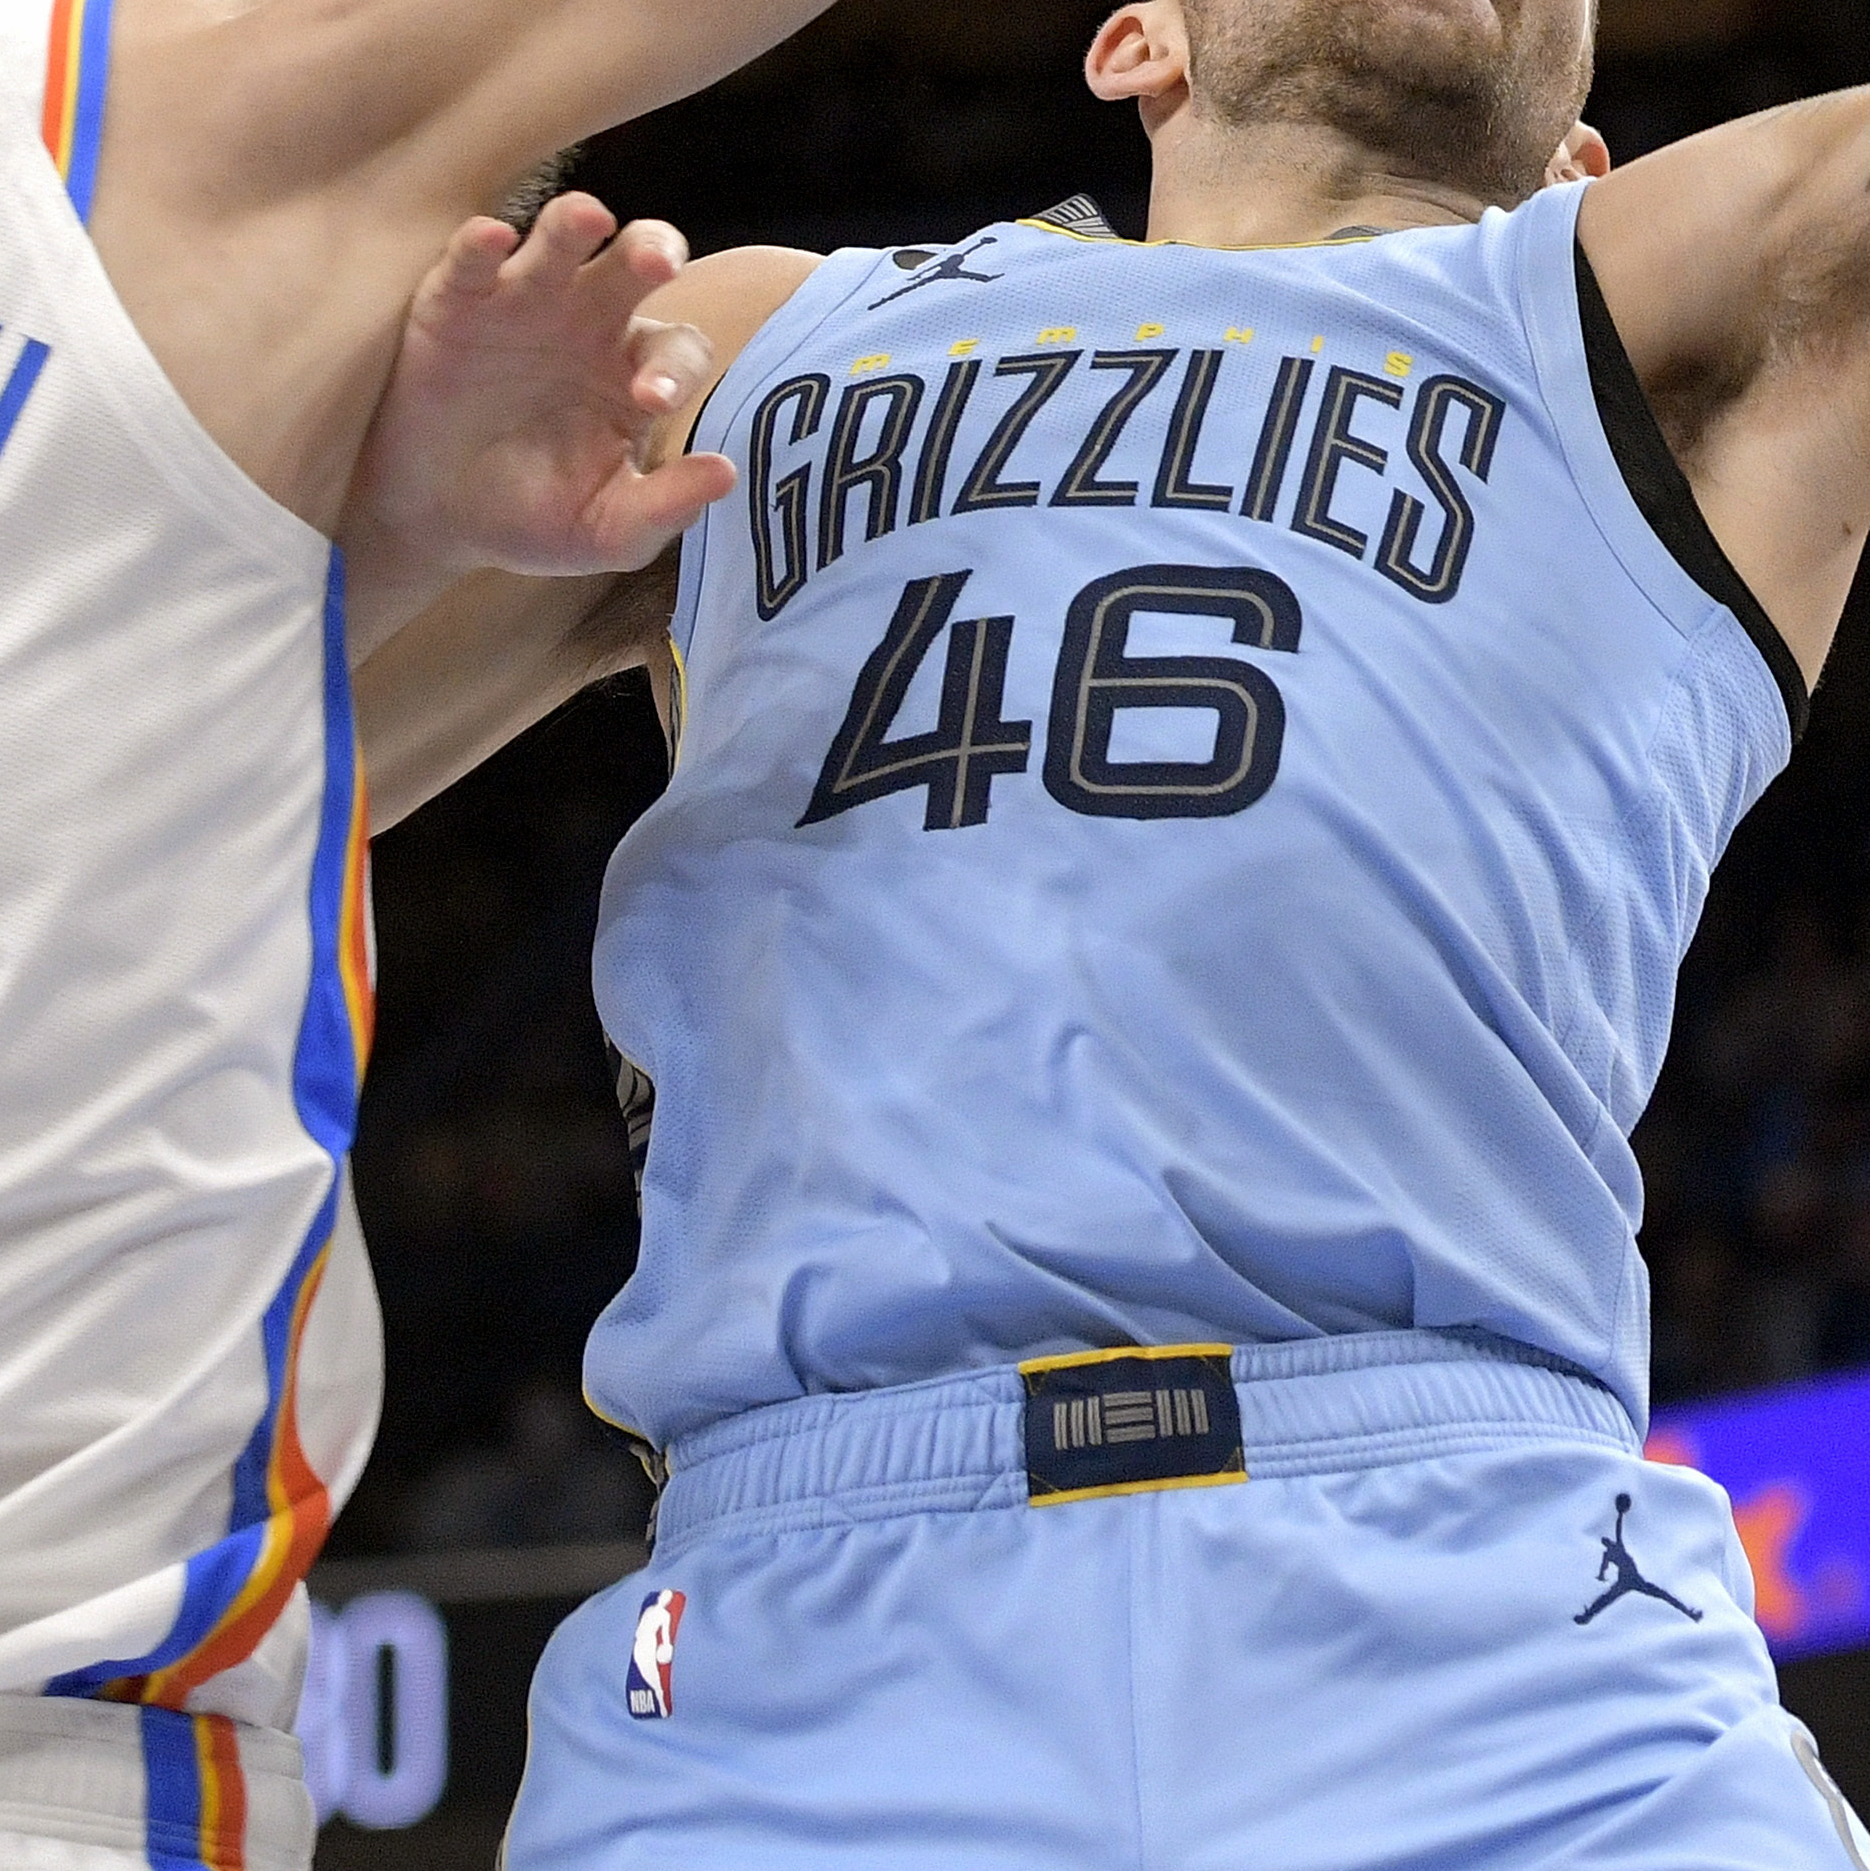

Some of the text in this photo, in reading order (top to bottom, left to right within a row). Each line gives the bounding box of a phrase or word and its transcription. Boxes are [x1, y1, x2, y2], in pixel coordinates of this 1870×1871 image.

[747, 346, 1506, 623] GRIZZLIES
[794, 563, 1303, 831] 46
[630, 1688, 656, 1714] NBA
